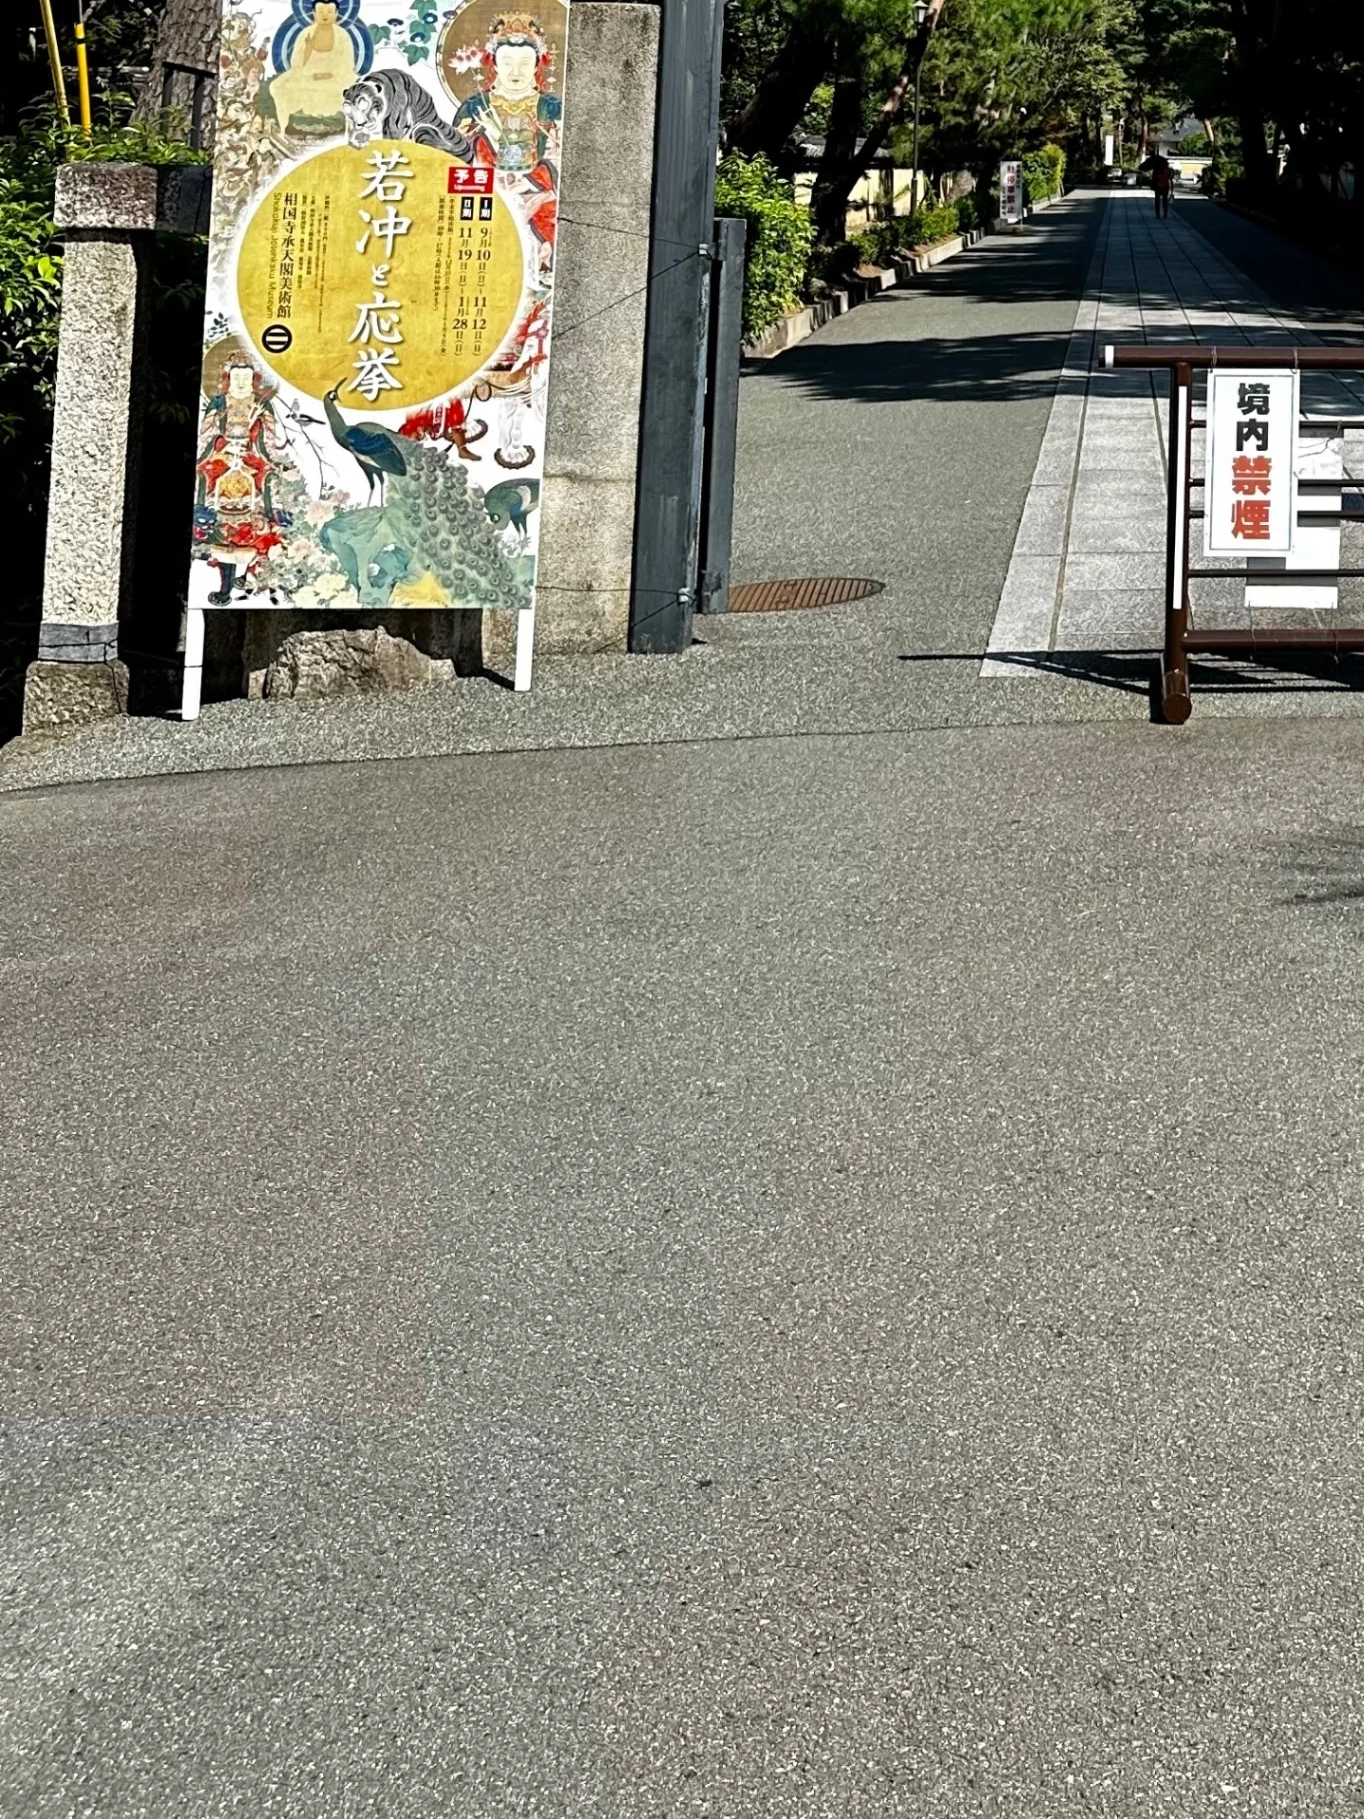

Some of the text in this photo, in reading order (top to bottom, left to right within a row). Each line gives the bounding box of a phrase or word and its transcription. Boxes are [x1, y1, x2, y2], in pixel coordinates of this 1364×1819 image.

[453, 168, 489, 184] 予告
[276, 192, 298, 319] 相国寺承天閣美術館
[347, 149, 414, 402] 若冲と応挙
[1231, 381, 1272, 540] 境内禁煙
